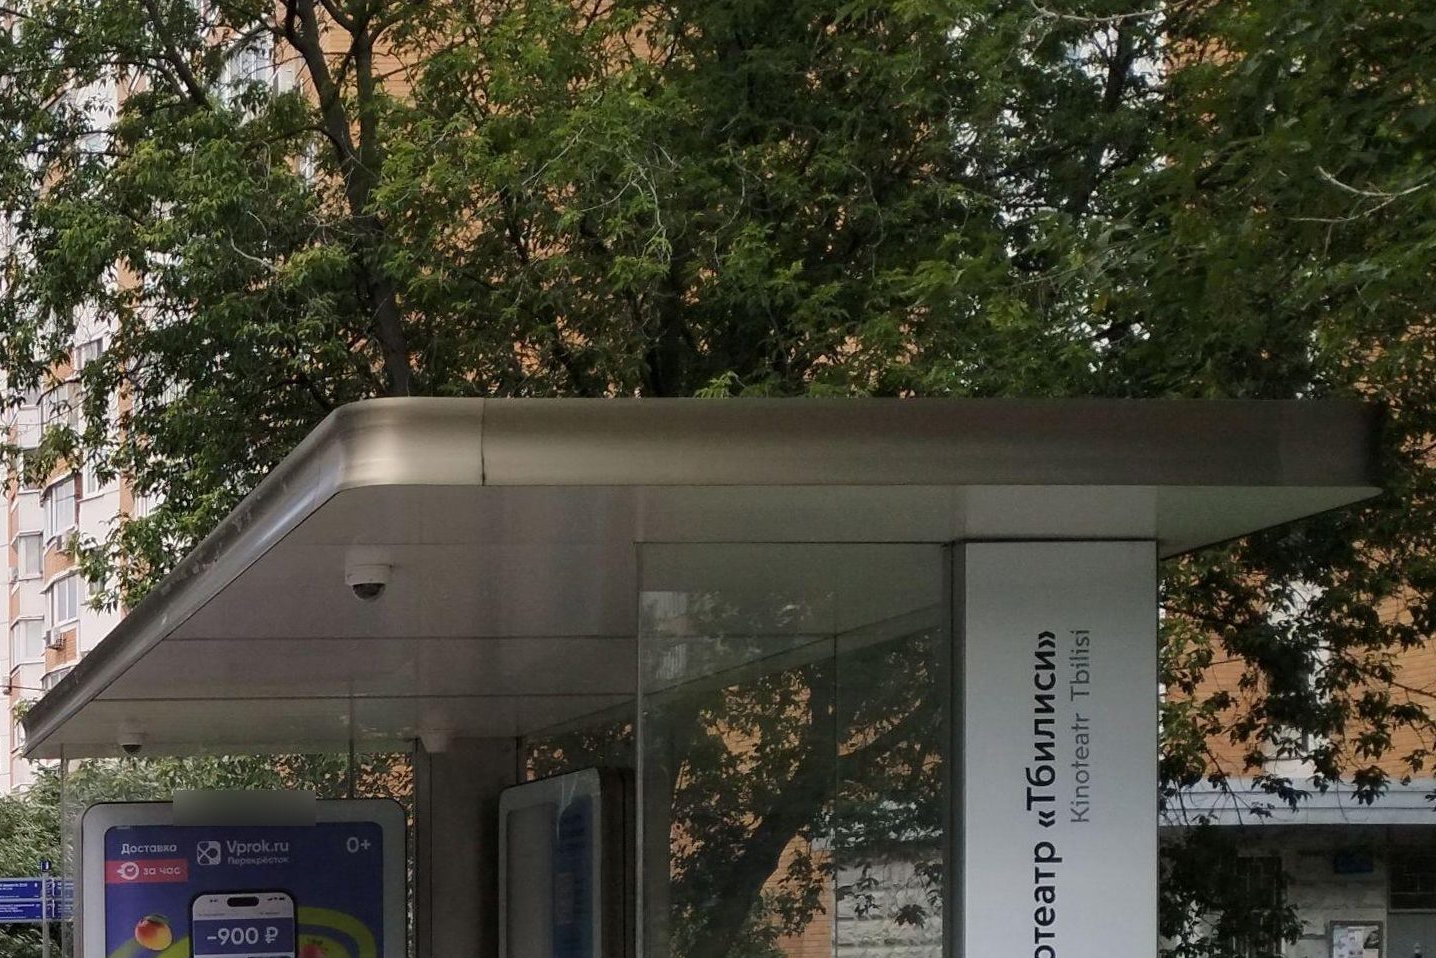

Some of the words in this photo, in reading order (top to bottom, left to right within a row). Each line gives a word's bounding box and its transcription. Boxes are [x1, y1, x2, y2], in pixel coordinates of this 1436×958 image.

[1069, 629, 1090, 701] Tbilisi
[1026, 630, 1057, 828] «Тбилиси»
[1071, 713, 1090, 823] Kinoteatr
[121, 843, 177, 855] Доставка
[227, 839, 289, 857] Vprok.ru
[346, 836, 371, 853] 0+
[143, 866, 157, 876] за
[159, 865, 181, 876] час
